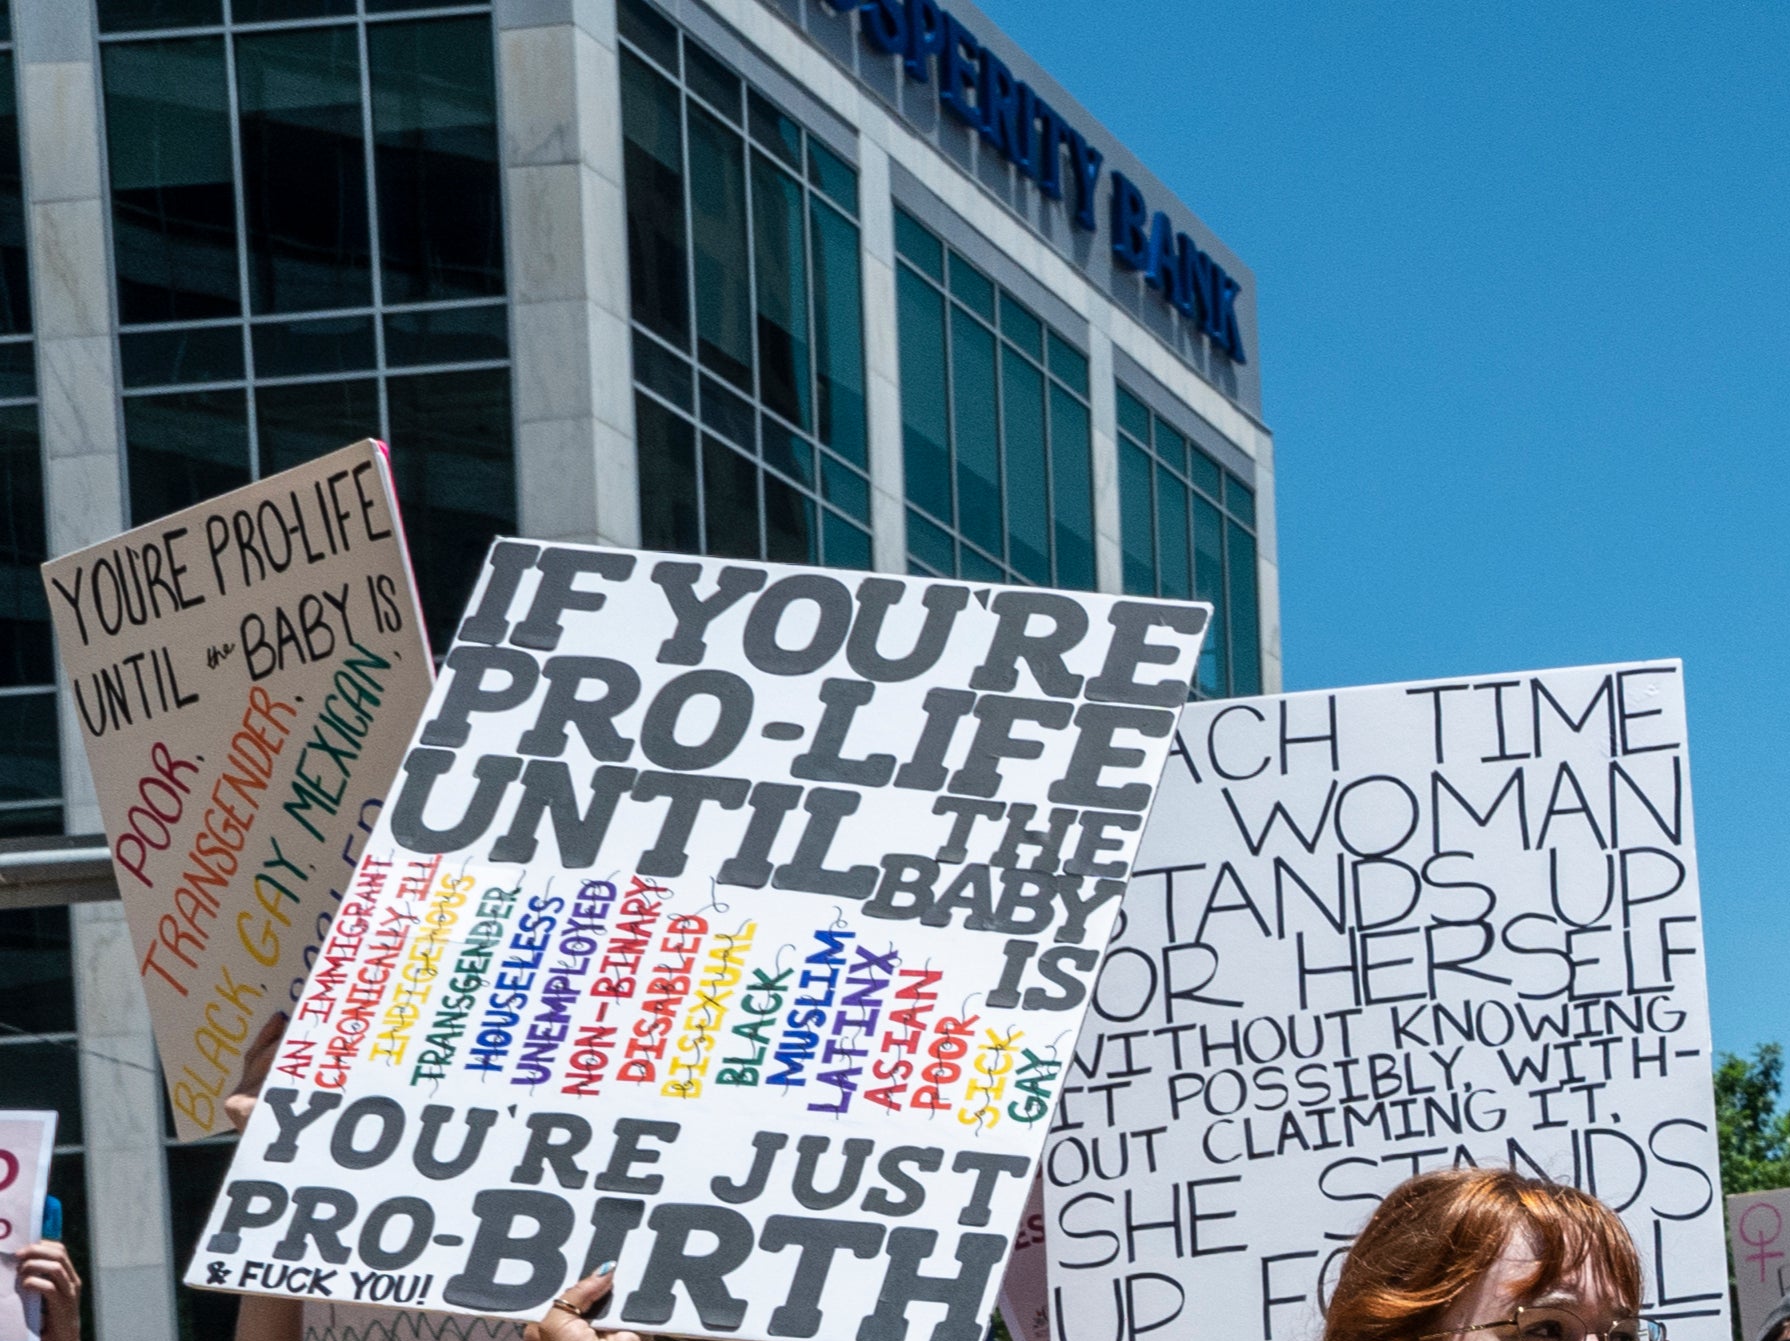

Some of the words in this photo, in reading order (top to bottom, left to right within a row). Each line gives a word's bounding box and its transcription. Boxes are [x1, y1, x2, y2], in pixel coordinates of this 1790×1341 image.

[1110, 170, 1247, 364] BANK
[52, 529, 205, 645] YOU'RE
[206, 461, 392, 596] PRO-LIFE
[458, 541, 637, 651] IF
[651, 560, 1210, 707] YOU'RE
[74, 646, 200, 738] UNTIL
[206, 643, 235, 671] the
[240, 583, 360, 682] BABY
[367, 574, 402, 634] IS
[1406, 666, 1681, 764] TIME
[420, 645, 1175, 812] PRO-LIFE
[391, 747, 880, 900] UNTIL
[932, 795, 1143, 878] THE
[1221, 756, 1683, 857] WOMAN
[278, 1039, 318, 1079] AN
[298, 854, 395, 1024] IMMIGRANT
[862, 853, 1125, 943] BABY
[1111, 849, 1498, 947] TANDS
[1548, 846, 1687, 929] UP
[315, 905, 418, 1089] CHRONICALLY
[369, 873, 477, 1066] INDIGENOUS
[410, 886, 522, 1087] TRANSGENDER
[464, 895, 565, 1072] HOUSELESS
[510, 879, 618, 1086] UNEMPLOYED
[616, 914, 710, 1083] DISABLED
[660, 921, 757, 1099] BISEXUAL
[715, 966, 796, 1087] BLACK
[766, 928, 856, 1087] MUSLIM
[807, 944, 899, 1114] LATINX
[985, 939, 1100, 1011] IS
[1092, 941, 1245, 1025] OR
[1298, 911, 1697, 1011] HERSELF
[1391, 995, 1688, 1051] KNOWING
[864, 968, 944, 1112] ASIAN
[910, 1013, 981, 1110] POOR
[957, 1027, 1025, 1129] SICK
[1007, 1048, 1063, 1123] GAY
[1051, 1081, 1133, 1133] IT
[1497, 1036, 1701, 1088] WITH-
[262, 1087, 681, 1196] YOU'RE
[711, 1128, 1031, 1228] JUST
[1046, 1127, 1169, 1188] OUT
[1202, 1088, 1507, 1165] CLAIMING
[205, 1259, 233, 1286] &
[238, 1259, 338, 1298] FUCK
[350, 1267, 434, 1307] YOU!
[1057, 1175, 1248, 1271] SHE
